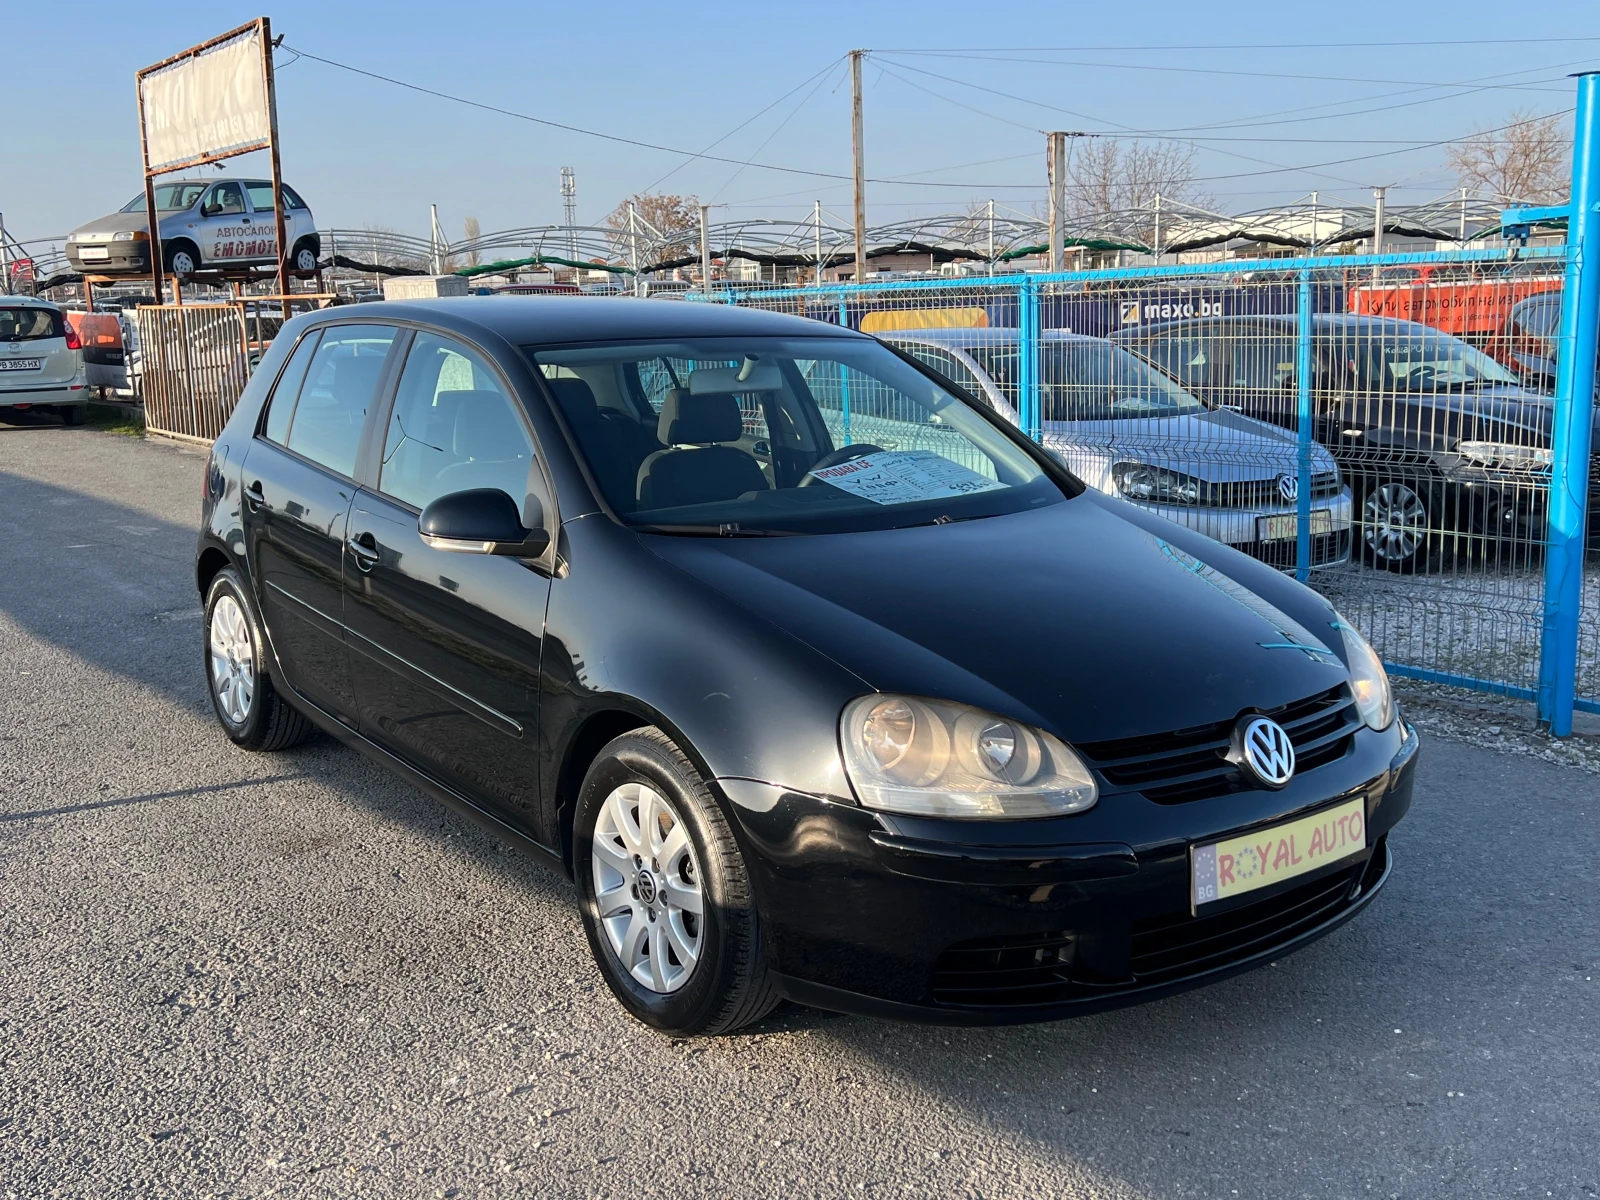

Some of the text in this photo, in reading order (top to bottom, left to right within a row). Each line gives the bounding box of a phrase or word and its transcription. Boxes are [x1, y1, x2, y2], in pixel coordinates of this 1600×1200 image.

[1144, 298, 1222, 319] maxo.bg
[1367, 299, 1399, 315] Купи
[1403, 295, 1475, 311] автомобил
[28, 360, 39, 368] HX
[814, 463, 861, 479] ПРОДАВА
[856, 459, 874, 469] СЕ
[1218, 811, 1363, 887] ROYAL AUTO
[1198, 884, 1214, 899] BG
